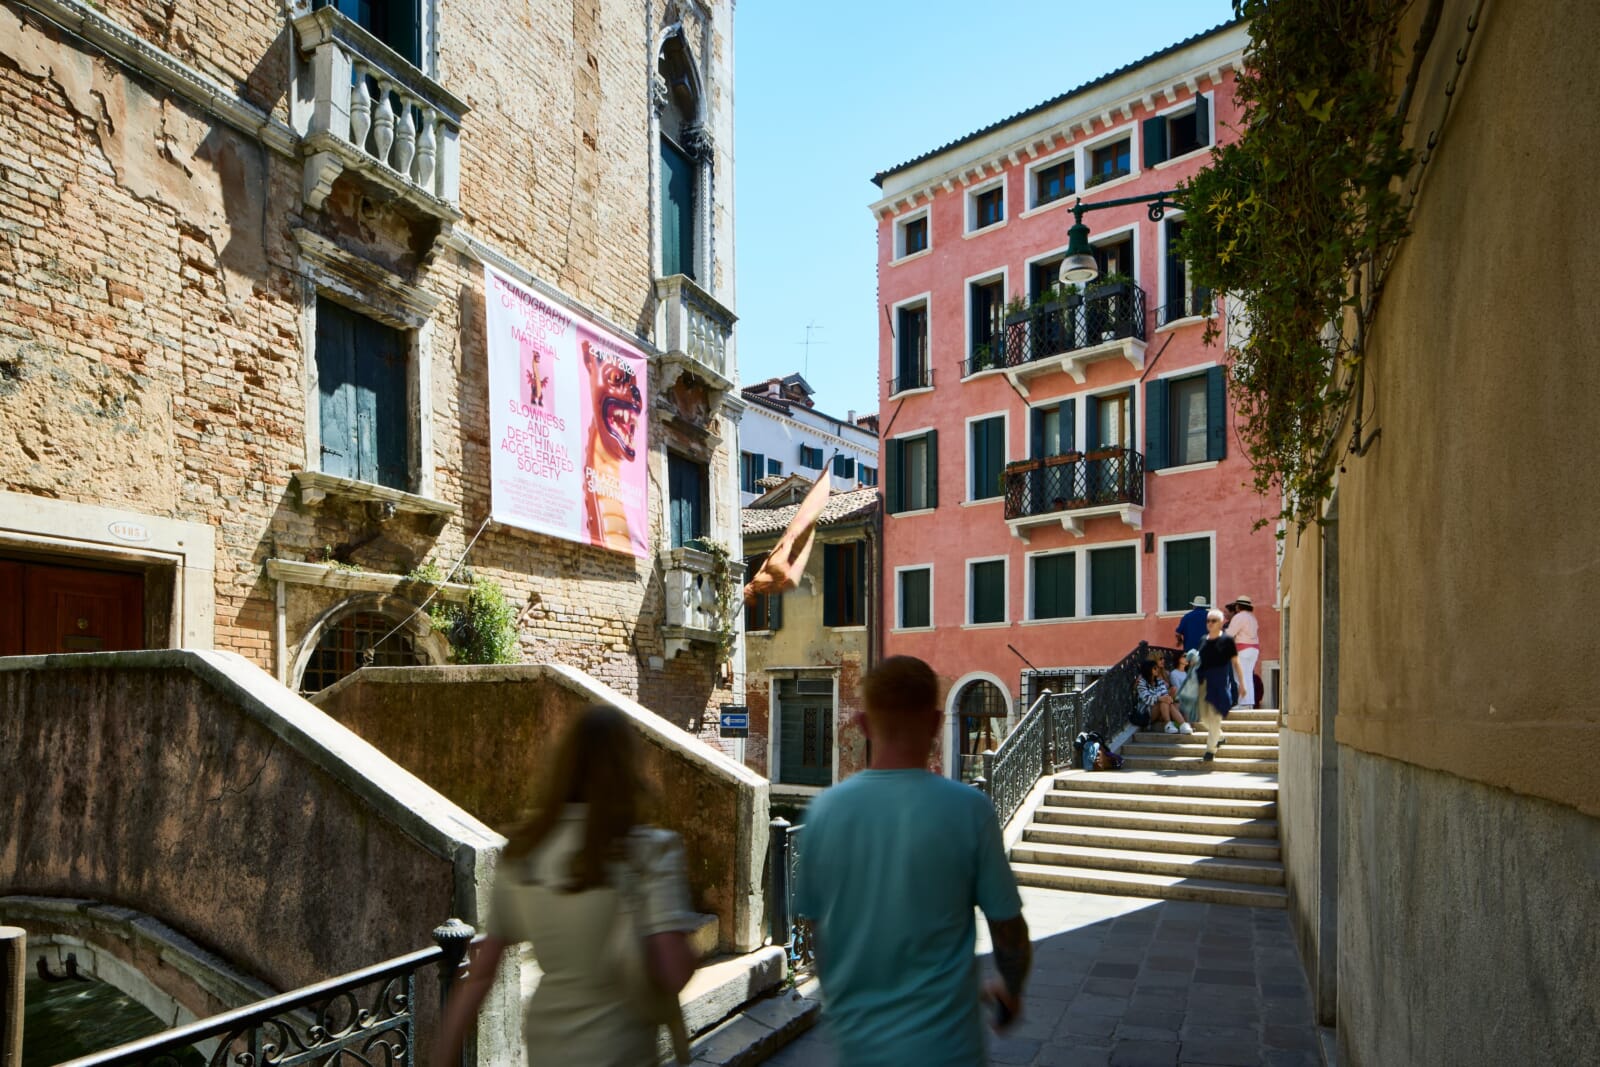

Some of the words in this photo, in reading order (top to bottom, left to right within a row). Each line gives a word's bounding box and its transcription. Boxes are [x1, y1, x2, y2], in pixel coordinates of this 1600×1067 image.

[494, 275, 572, 328] ETHNOGRAPHY
[501, 293, 514, 310] OF
[519, 302, 537, 321] THE
[538, 313, 566, 337] BODY
[511, 325, 561, 361] MATERIAL
[525, 319, 546, 341] AND
[509, 399, 566, 432] SLOWNESS
[527, 420, 550, 438] AND
[501, 438, 574, 473] ACCELERATED
[507, 425, 543, 450] DEPTH
[543, 439, 554, 454] IN
[555, 444, 569, 459] AN
[517, 456, 561, 480] SOCIETY
